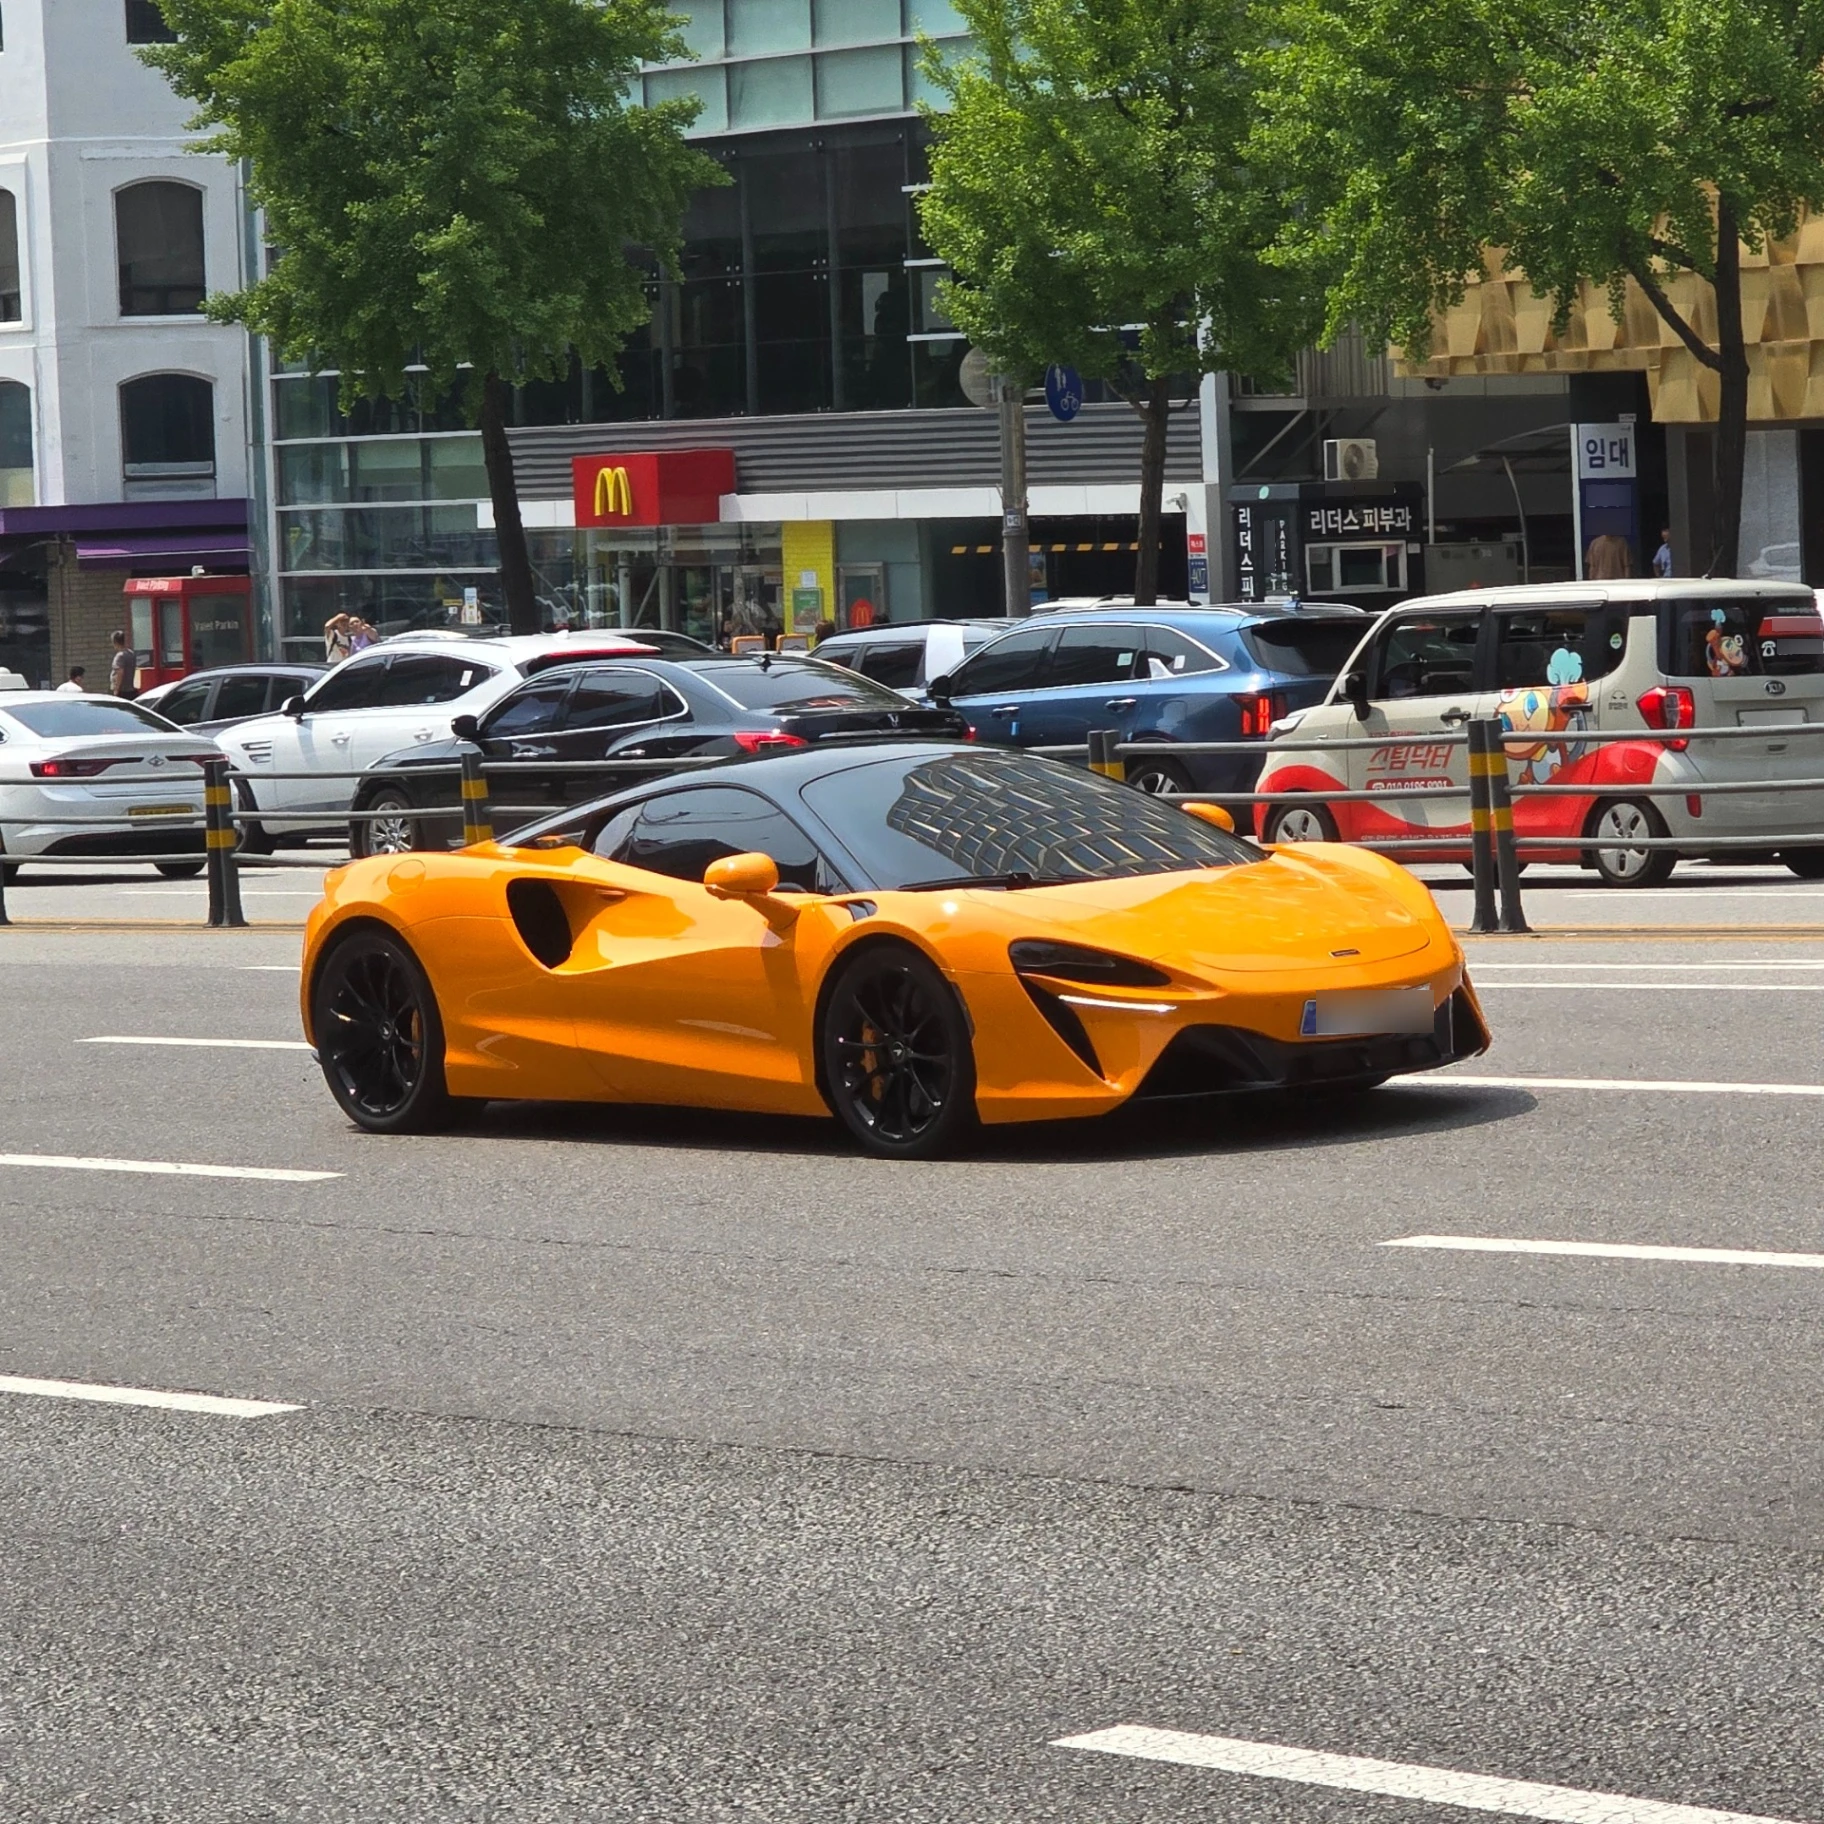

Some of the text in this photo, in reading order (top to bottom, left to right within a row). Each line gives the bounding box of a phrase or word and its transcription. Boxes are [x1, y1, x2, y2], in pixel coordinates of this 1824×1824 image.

[1585, 437, 1629, 469] 임대
[1310, 506, 1412, 535] 리더스 피부과
[1279, 520, 1288, 591] PARKING
[1366, 743, 1455, 772] 스팀닥터
